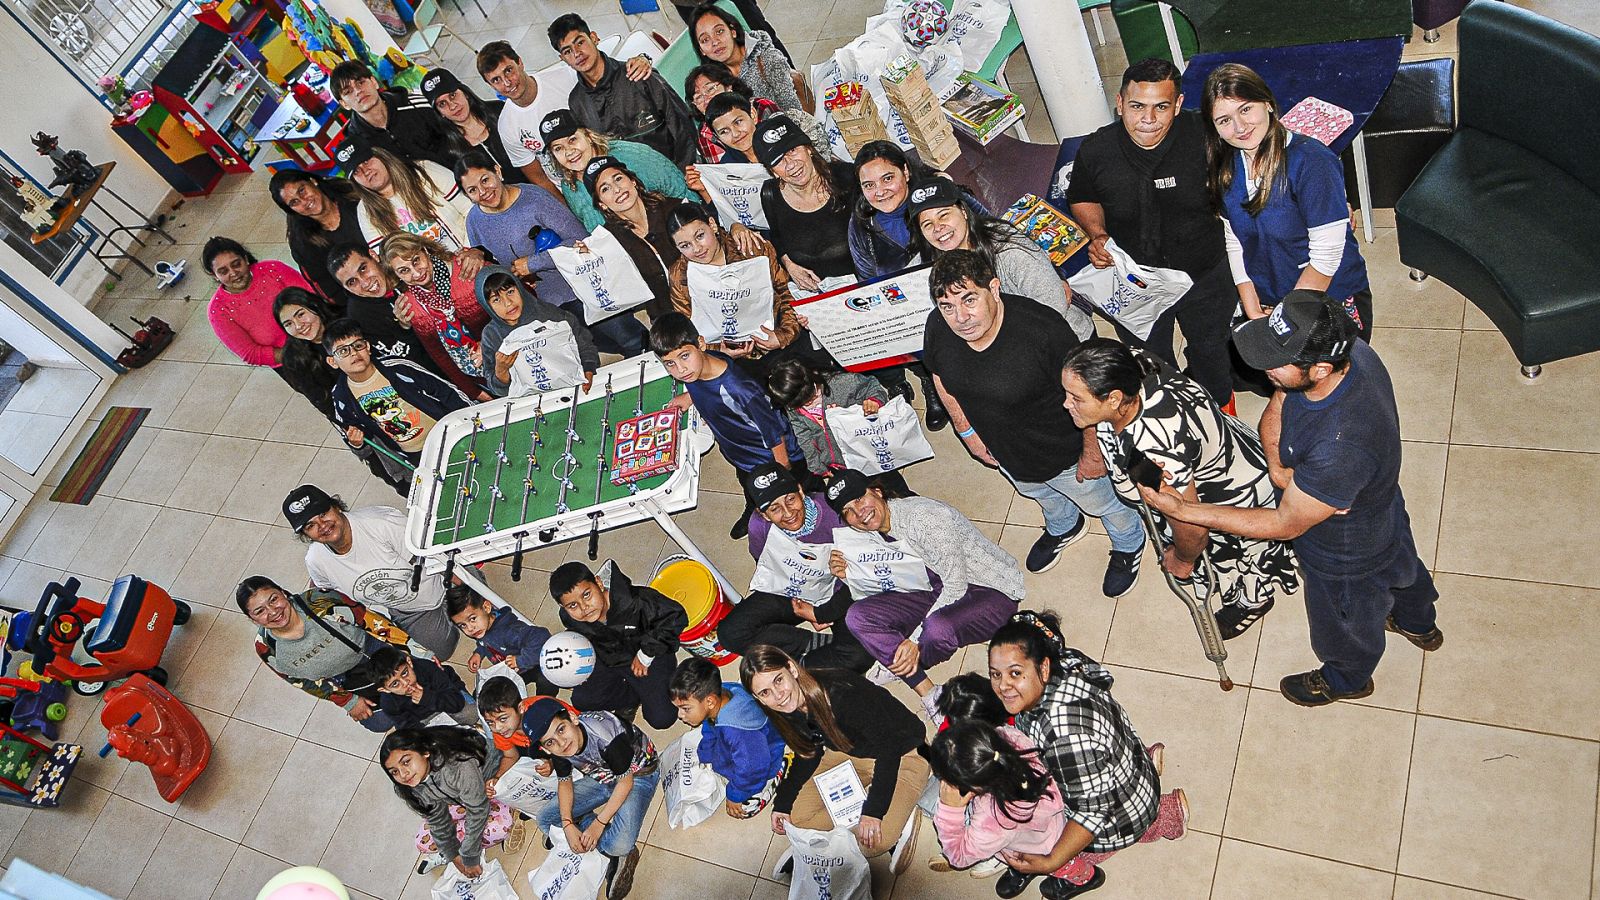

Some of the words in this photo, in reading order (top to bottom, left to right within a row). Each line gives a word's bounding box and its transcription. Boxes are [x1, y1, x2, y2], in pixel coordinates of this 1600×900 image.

[708, 288, 751, 301] APATITO
[857, 551, 904, 562] APATITO
[783, 557, 825, 577] APATITO
[355, 570, 389, 592] Creación
[545, 647, 563, 670] 10
